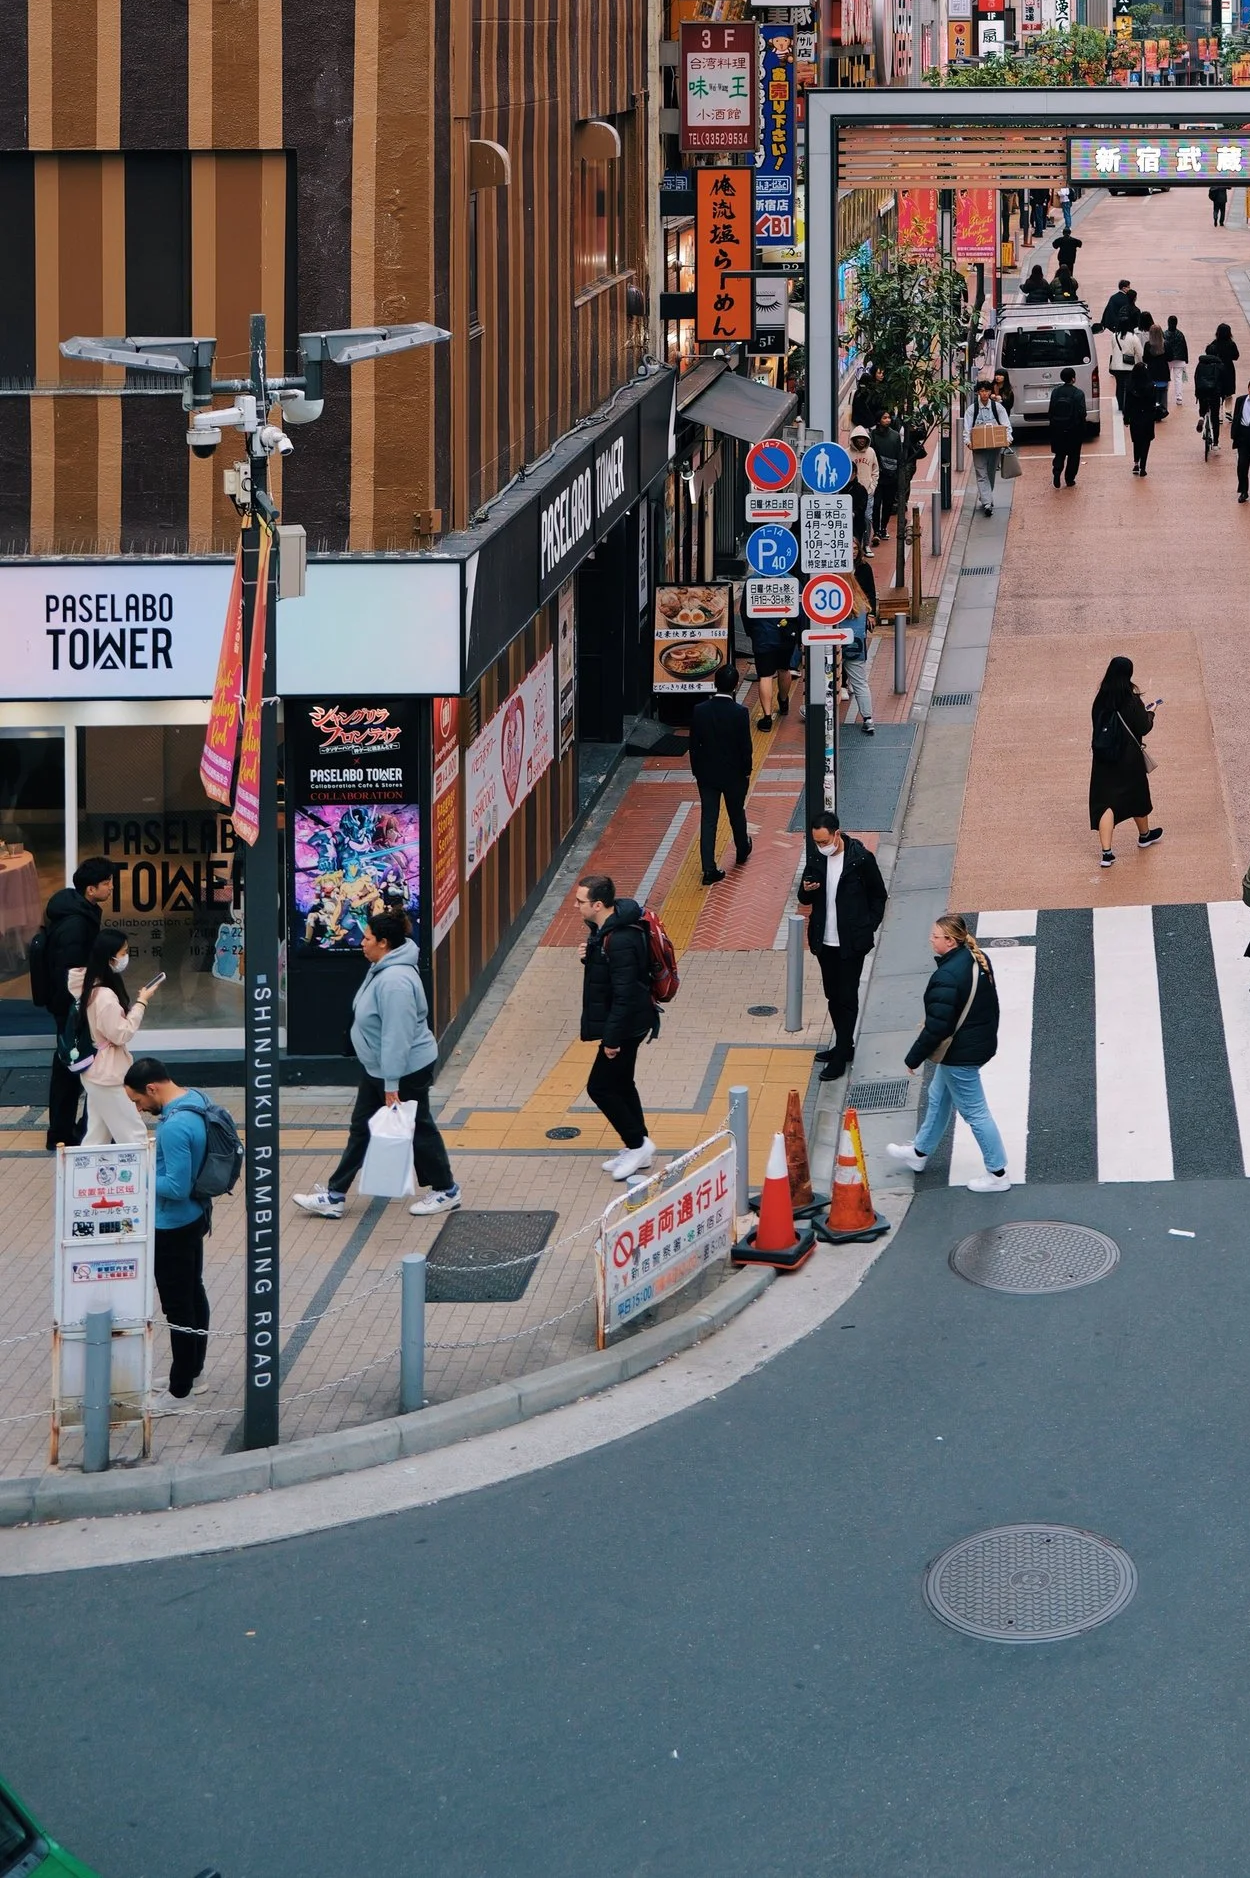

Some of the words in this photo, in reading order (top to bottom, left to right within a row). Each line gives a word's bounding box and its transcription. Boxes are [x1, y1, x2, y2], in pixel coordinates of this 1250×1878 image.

[986, 12, 996, 20] 1F
[690, 57, 747, 70] 台湾料理
[696, 108, 742, 121] 小酒館
[688, 132, 749, 146] TEL(3352)9534
[770, 215, 791, 237] B1
[709, 173, 741, 337] 俺流塩らーめん
[758, 335, 776, 348] 5F
[541, 466, 592, 580] PASELABO
[758, 538, 778, 570] P
[45, 592, 174, 623] PASELABO
[814, 588, 842, 611] 30
[45, 626, 174, 671] TOWER
[310, 768, 364, 782] PASELABO
[365, 767, 403, 781] TOWER
[310, 791, 404, 801] COLLABORATION
[103, 819, 244, 856] PASELAB
[254, 986, 272, 1129] SHINJUKU
[78, 1185, 135, 1197] 放置禁止区域
[254, 1146, 272, 1295] RAMBLING
[637, 1170, 729, 1249] 車両通行止
[254, 1313, 272, 1389] ROAD
